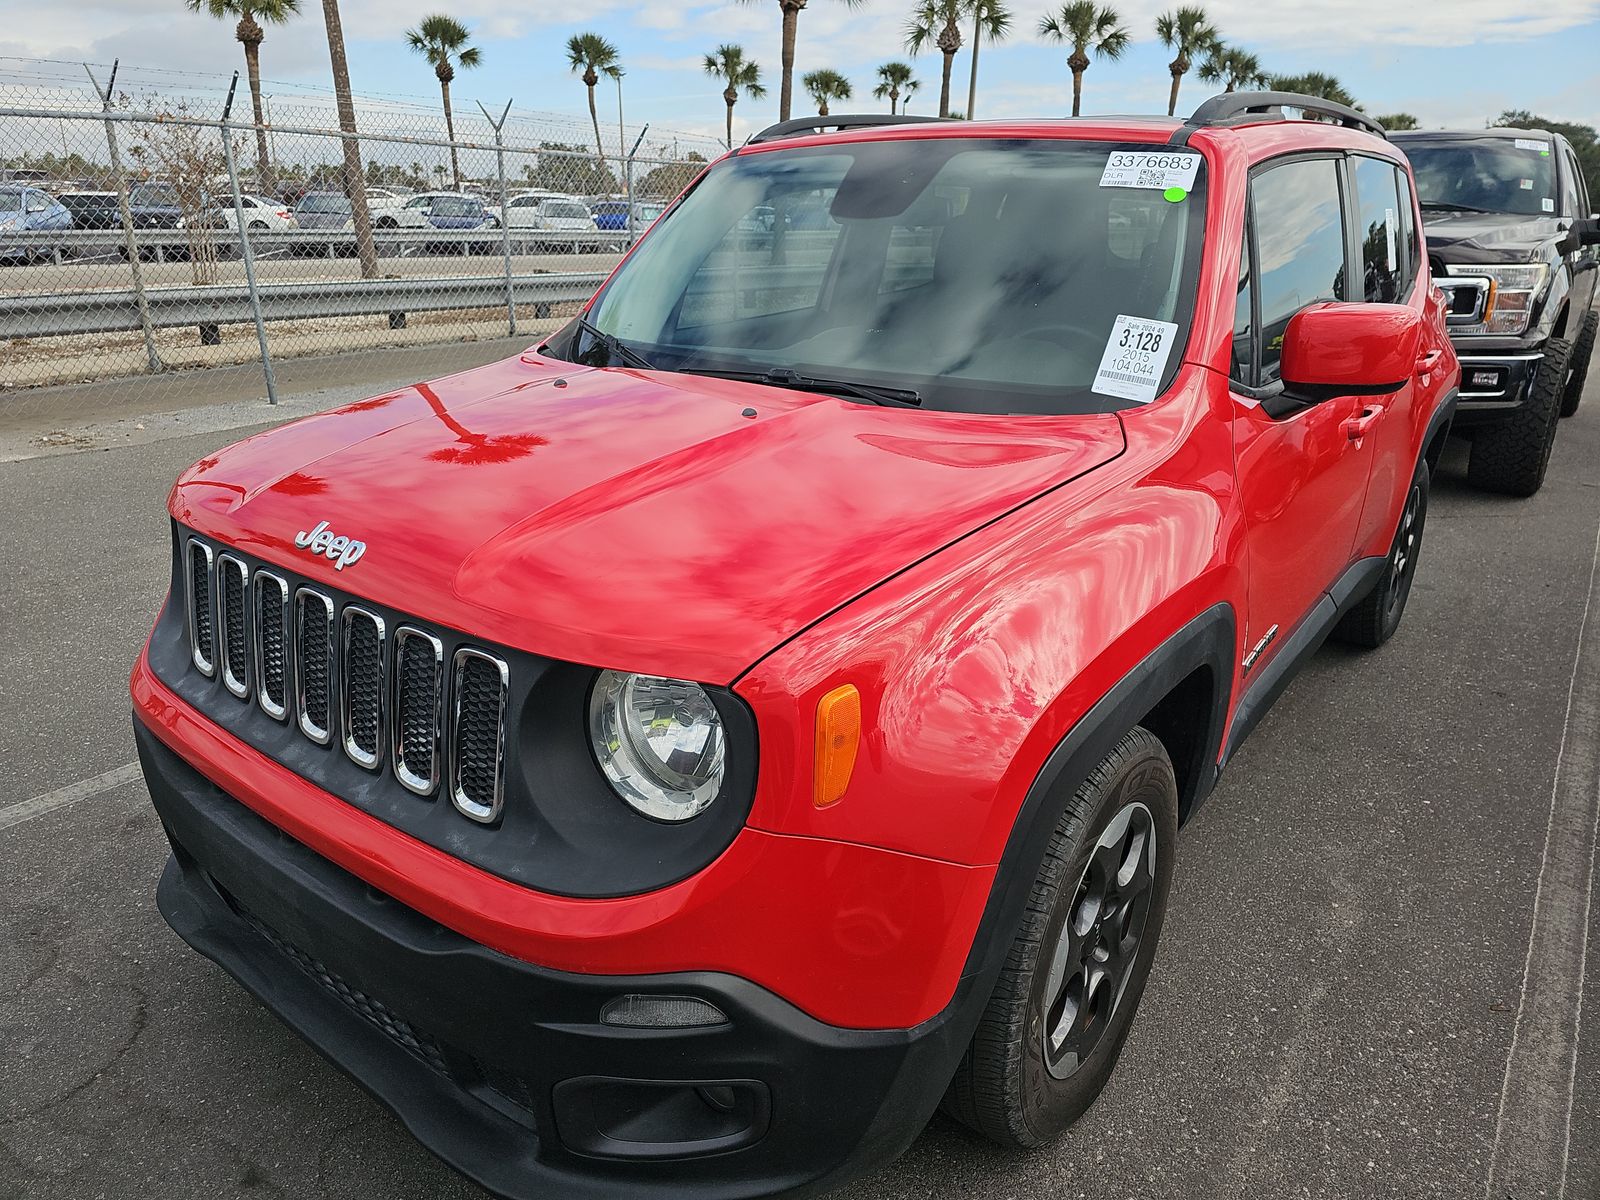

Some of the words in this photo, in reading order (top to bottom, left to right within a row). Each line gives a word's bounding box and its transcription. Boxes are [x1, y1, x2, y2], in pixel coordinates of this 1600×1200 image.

[1111, 155, 1192, 170] 3376683
[1127, 322, 1140, 331] Sale
[1141, 325, 1156, 333] 2024
[1120, 329, 1162, 352] 3:128
[1122, 349, 1151, 363] 2015
[1112, 359, 1154, 376] 104,044
[294, 520, 367, 571] Jeep
